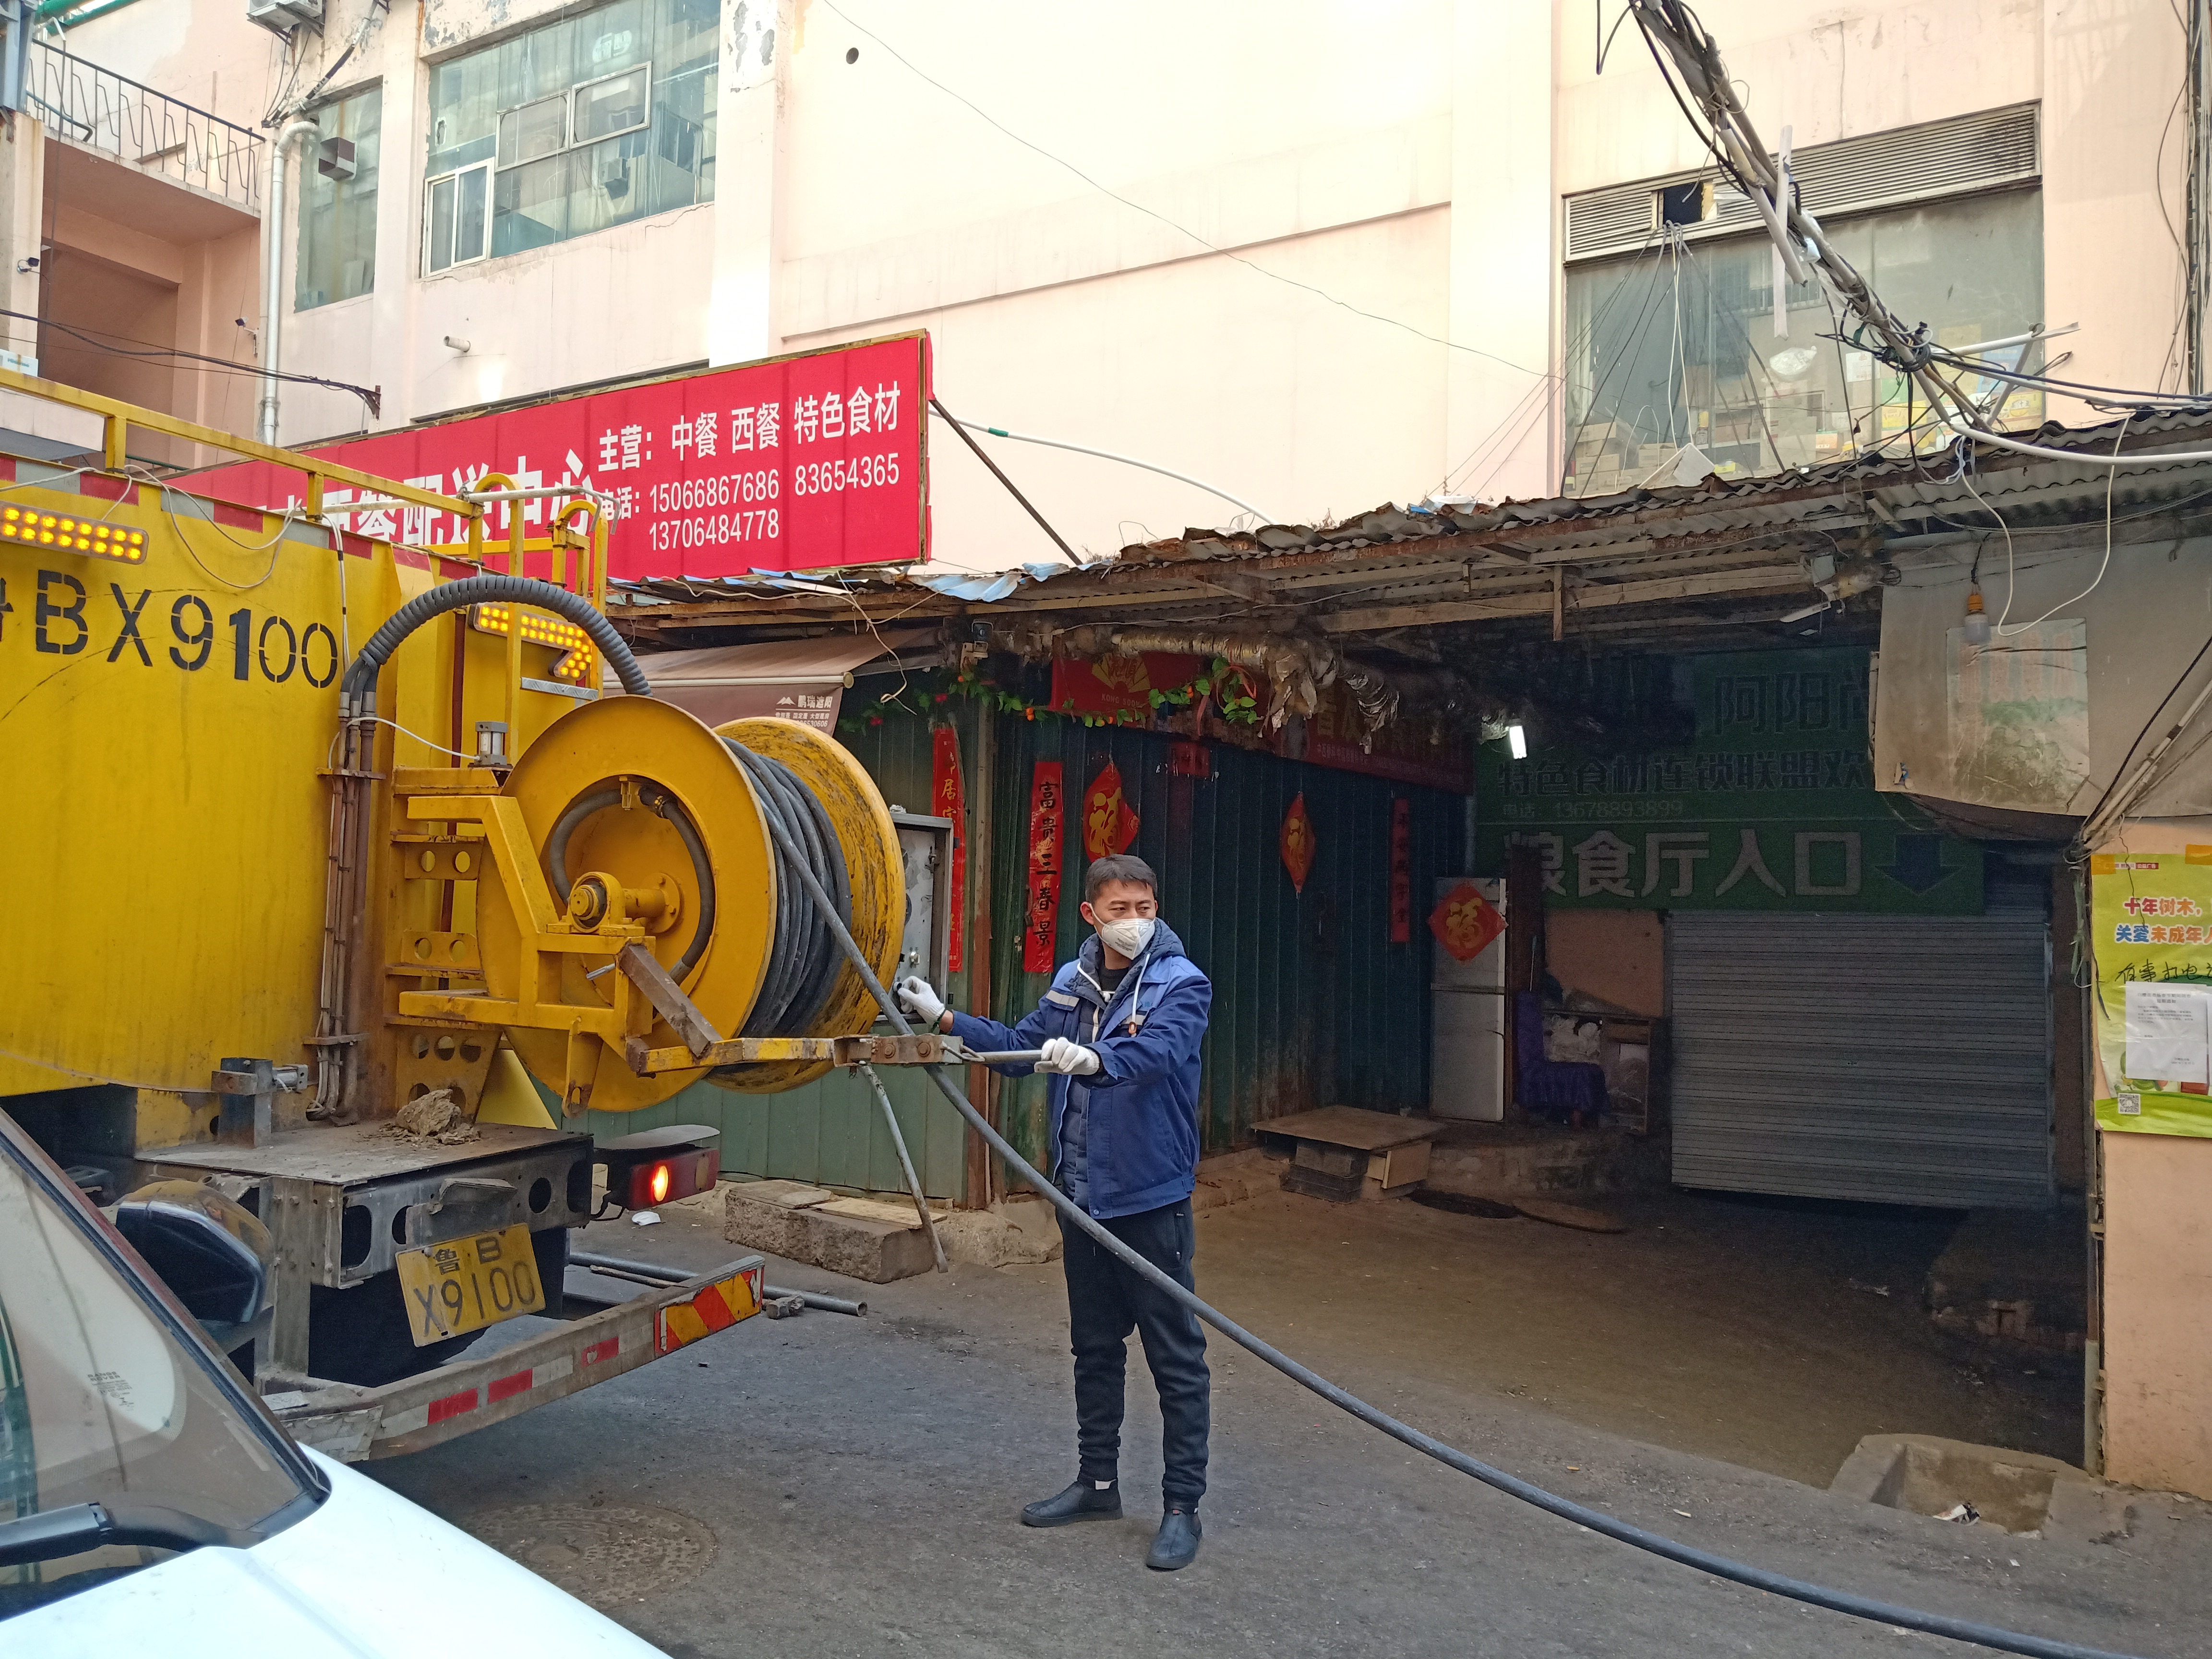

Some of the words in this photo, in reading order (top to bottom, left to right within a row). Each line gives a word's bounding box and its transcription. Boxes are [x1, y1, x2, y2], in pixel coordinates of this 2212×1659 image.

[598, 425, 651, 472] 主营：
[672, 412, 718, 461] 中餐
[731, 402, 780, 454] 西餐
[793, 381, 901, 444] 特色食材
[649, 469, 780, 513] 15066867686
[795, 452, 900, 496] 83654365
[649, 508, 780, 551] 13706484778
[0, 569, 338, 688] BX9100
[1033, 781, 1060, 947] 富贵三春景
[413, 1261, 536, 1337] X9100
